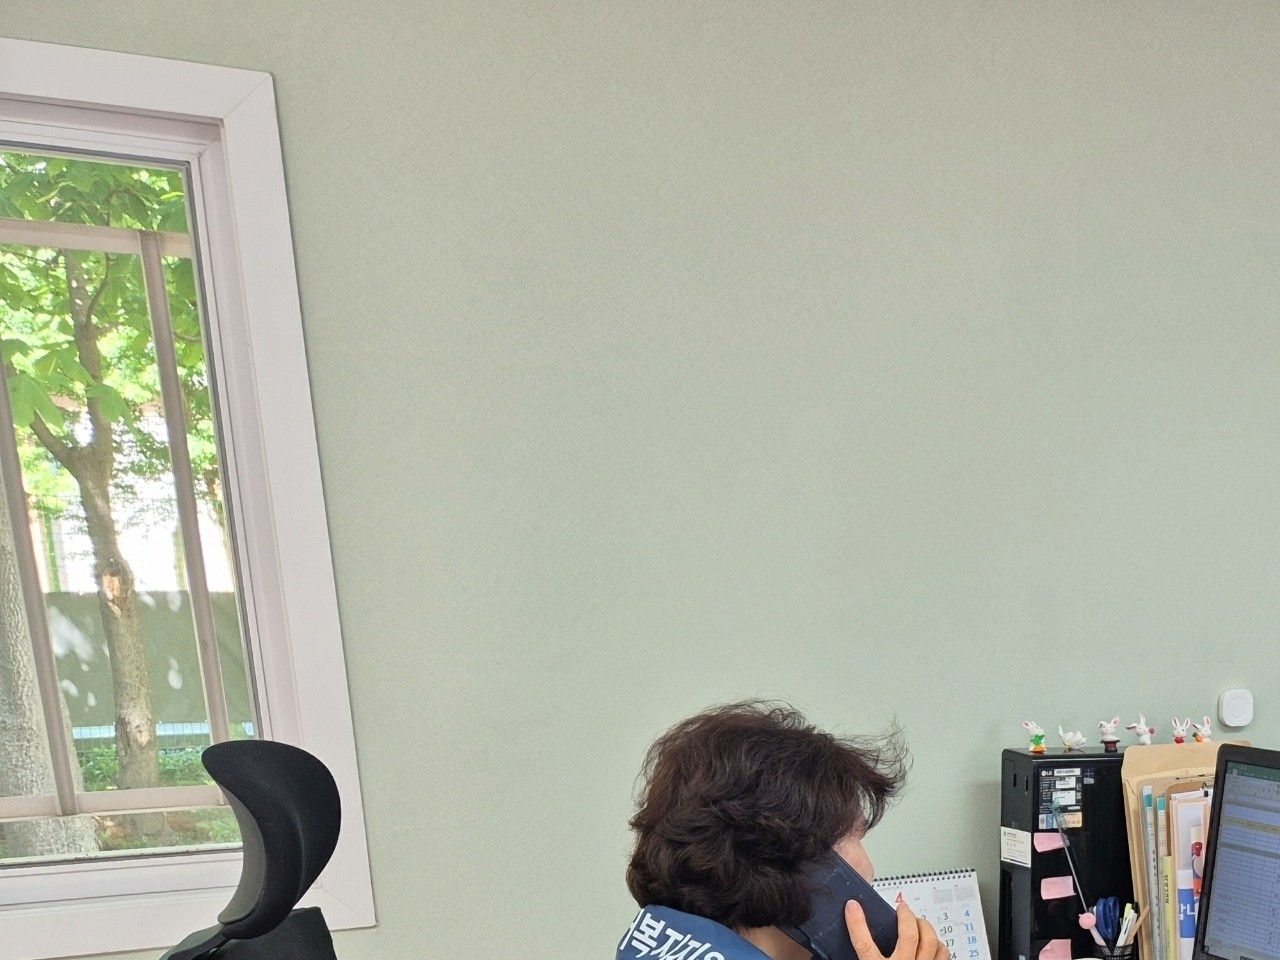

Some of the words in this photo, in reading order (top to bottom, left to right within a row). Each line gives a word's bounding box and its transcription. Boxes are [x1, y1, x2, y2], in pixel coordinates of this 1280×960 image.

[895, 891, 905, 904] 4
[943, 912, 949, 921] 3
[964, 909, 971, 918] 4
[944, 925, 953, 934] 10
[965, 923, 975, 932] 11
[945, 938, 955, 948] 17
[967, 935, 978, 945] 18
[969, 949, 980, 958] 25
